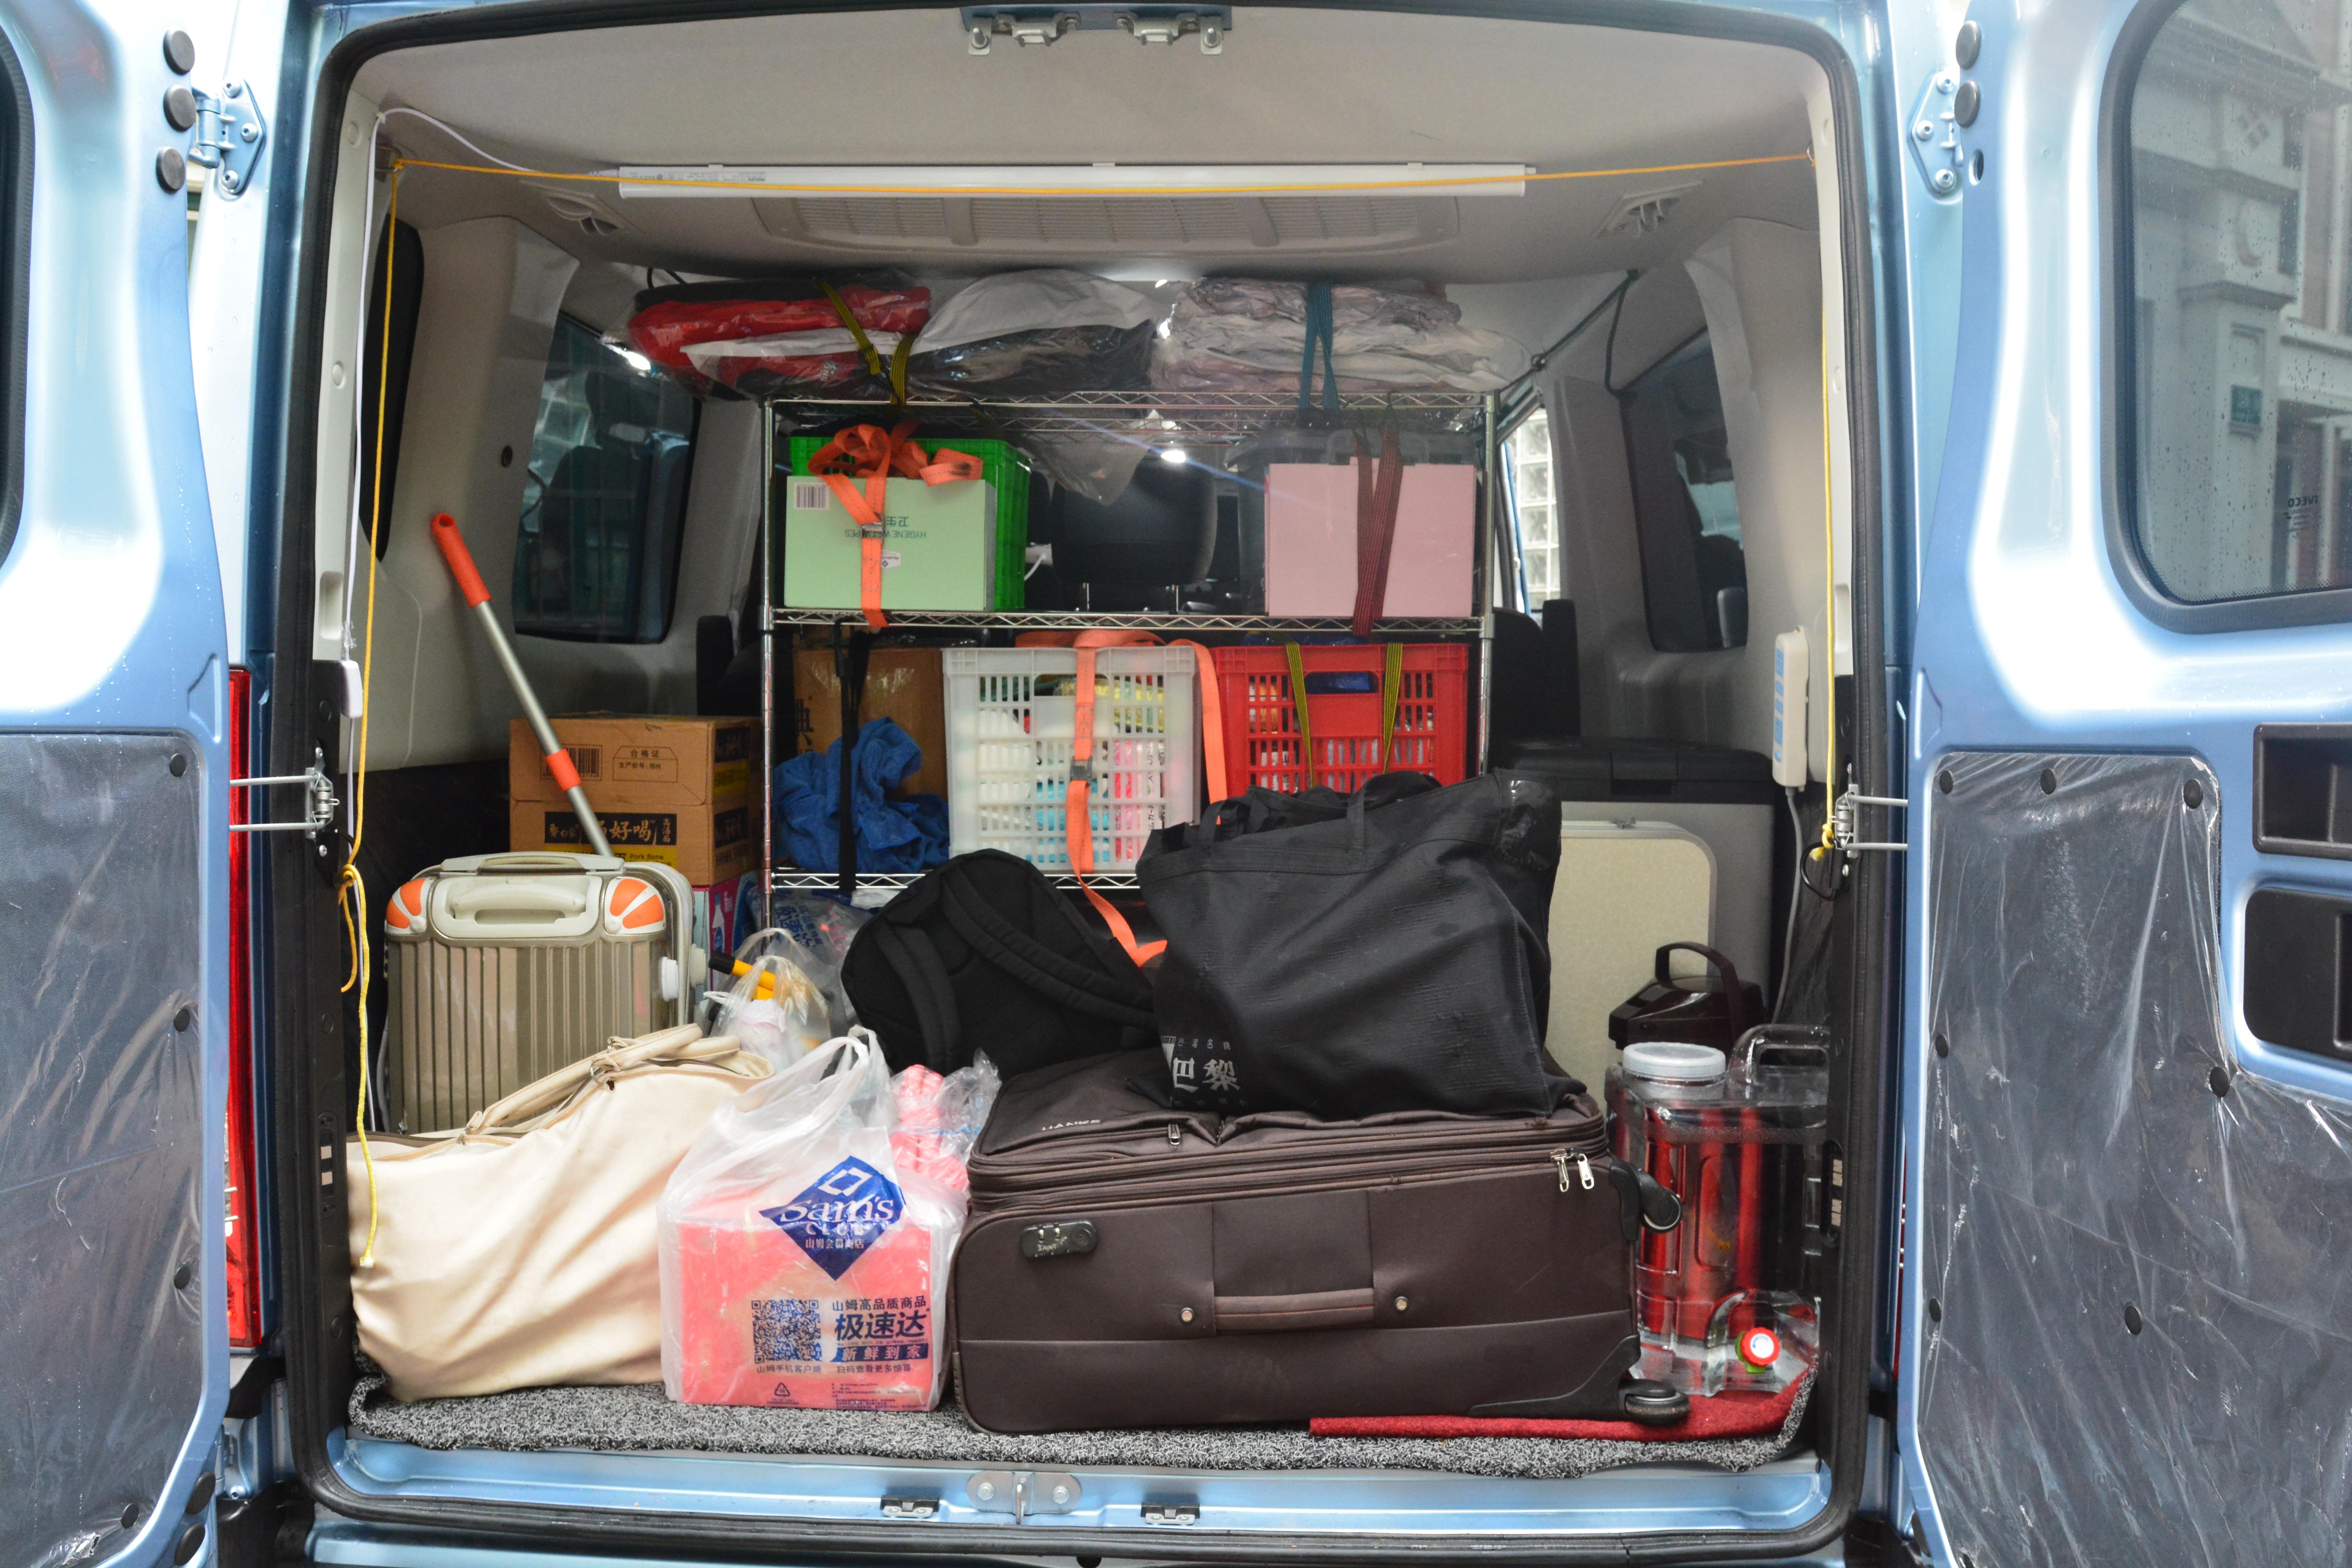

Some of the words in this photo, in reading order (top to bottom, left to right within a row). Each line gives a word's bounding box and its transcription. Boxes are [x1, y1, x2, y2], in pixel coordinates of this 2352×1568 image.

[844, 529, 871, 538] WPES
[893, 530, 926, 539] HYGIENE
[630, 749, 660, 758] 合格证
[1173, 1057, 1241, 1093] 巴黎
[780, 1196, 894, 1223] Sam's
[806, 1222, 865, 1236] CLUB
[832, 1295, 926, 1312] 山姆高品质商品
[835, 1310, 927, 1341] 极速达
[842, 1344, 921, 1361] 新鲜到家
[757, 1365, 822, 1374] 山姆手机客户端
[837, 1363, 911, 1374] 扫码查看更多惊喜
